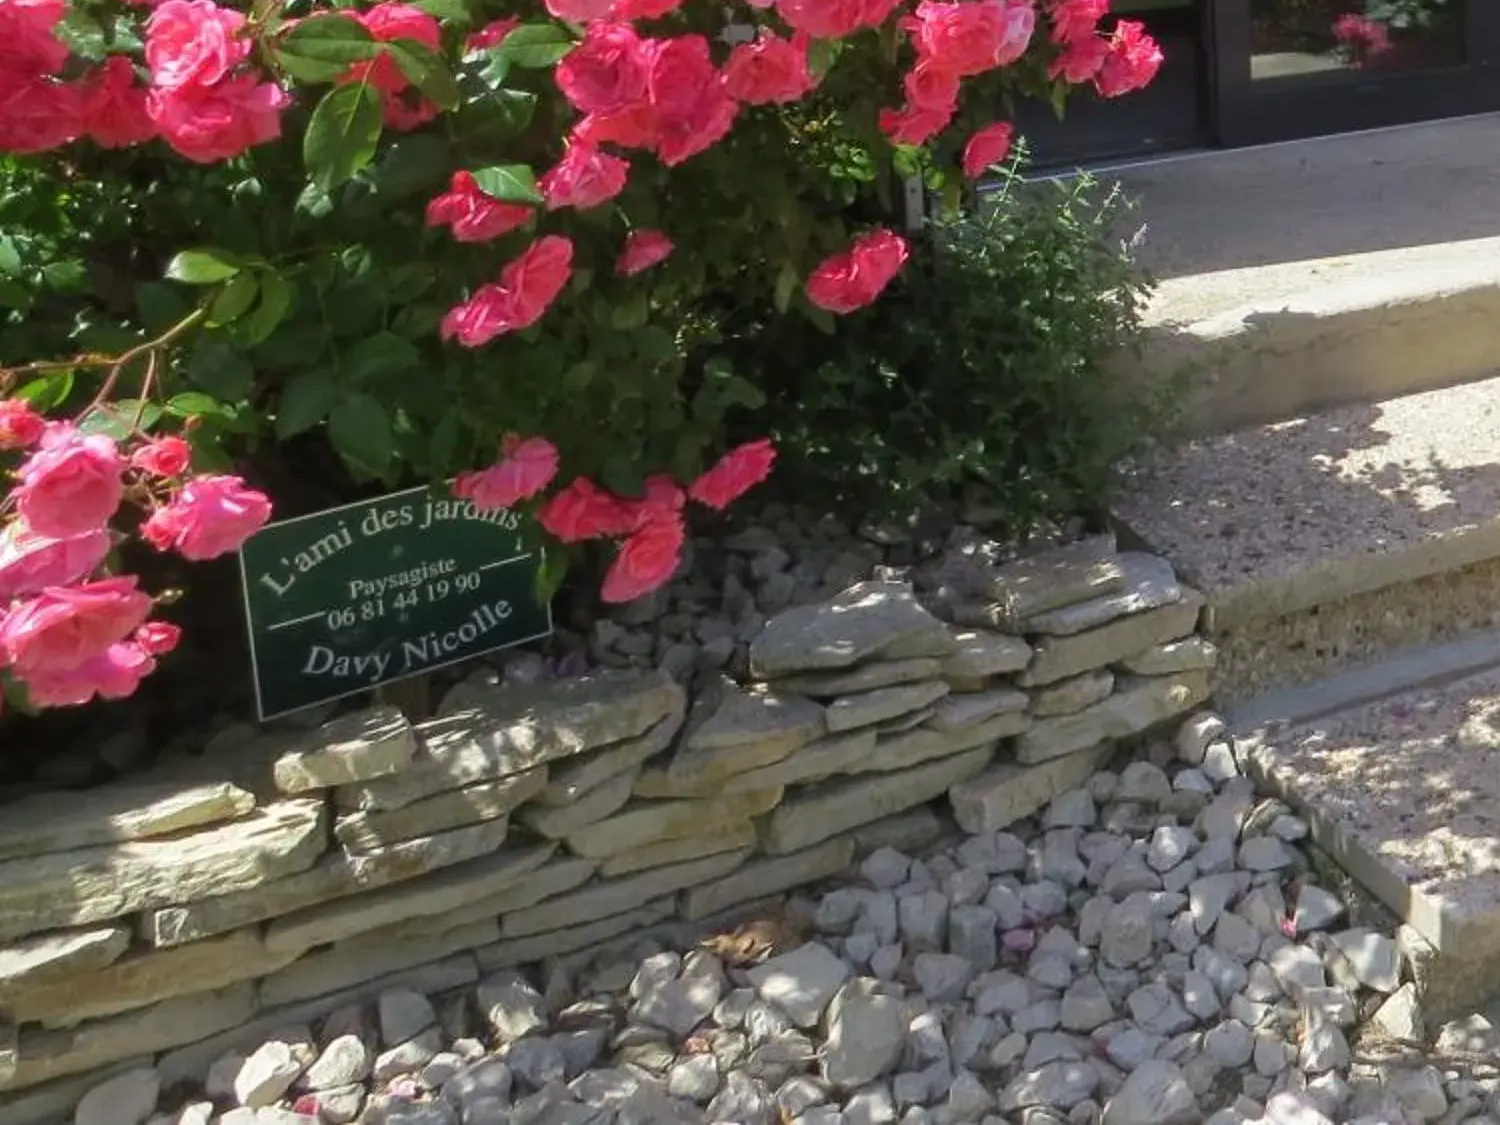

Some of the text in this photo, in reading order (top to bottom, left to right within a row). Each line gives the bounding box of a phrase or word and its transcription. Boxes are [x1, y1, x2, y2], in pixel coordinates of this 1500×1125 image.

[260, 518, 354, 597] L'ami
[361, 504, 414, 538] des
[350, 557, 458, 600] Paysagiste
[327, 572, 482, 632] 06 81 44 19 90
[303, 597, 514, 682] Davy Nicolle
